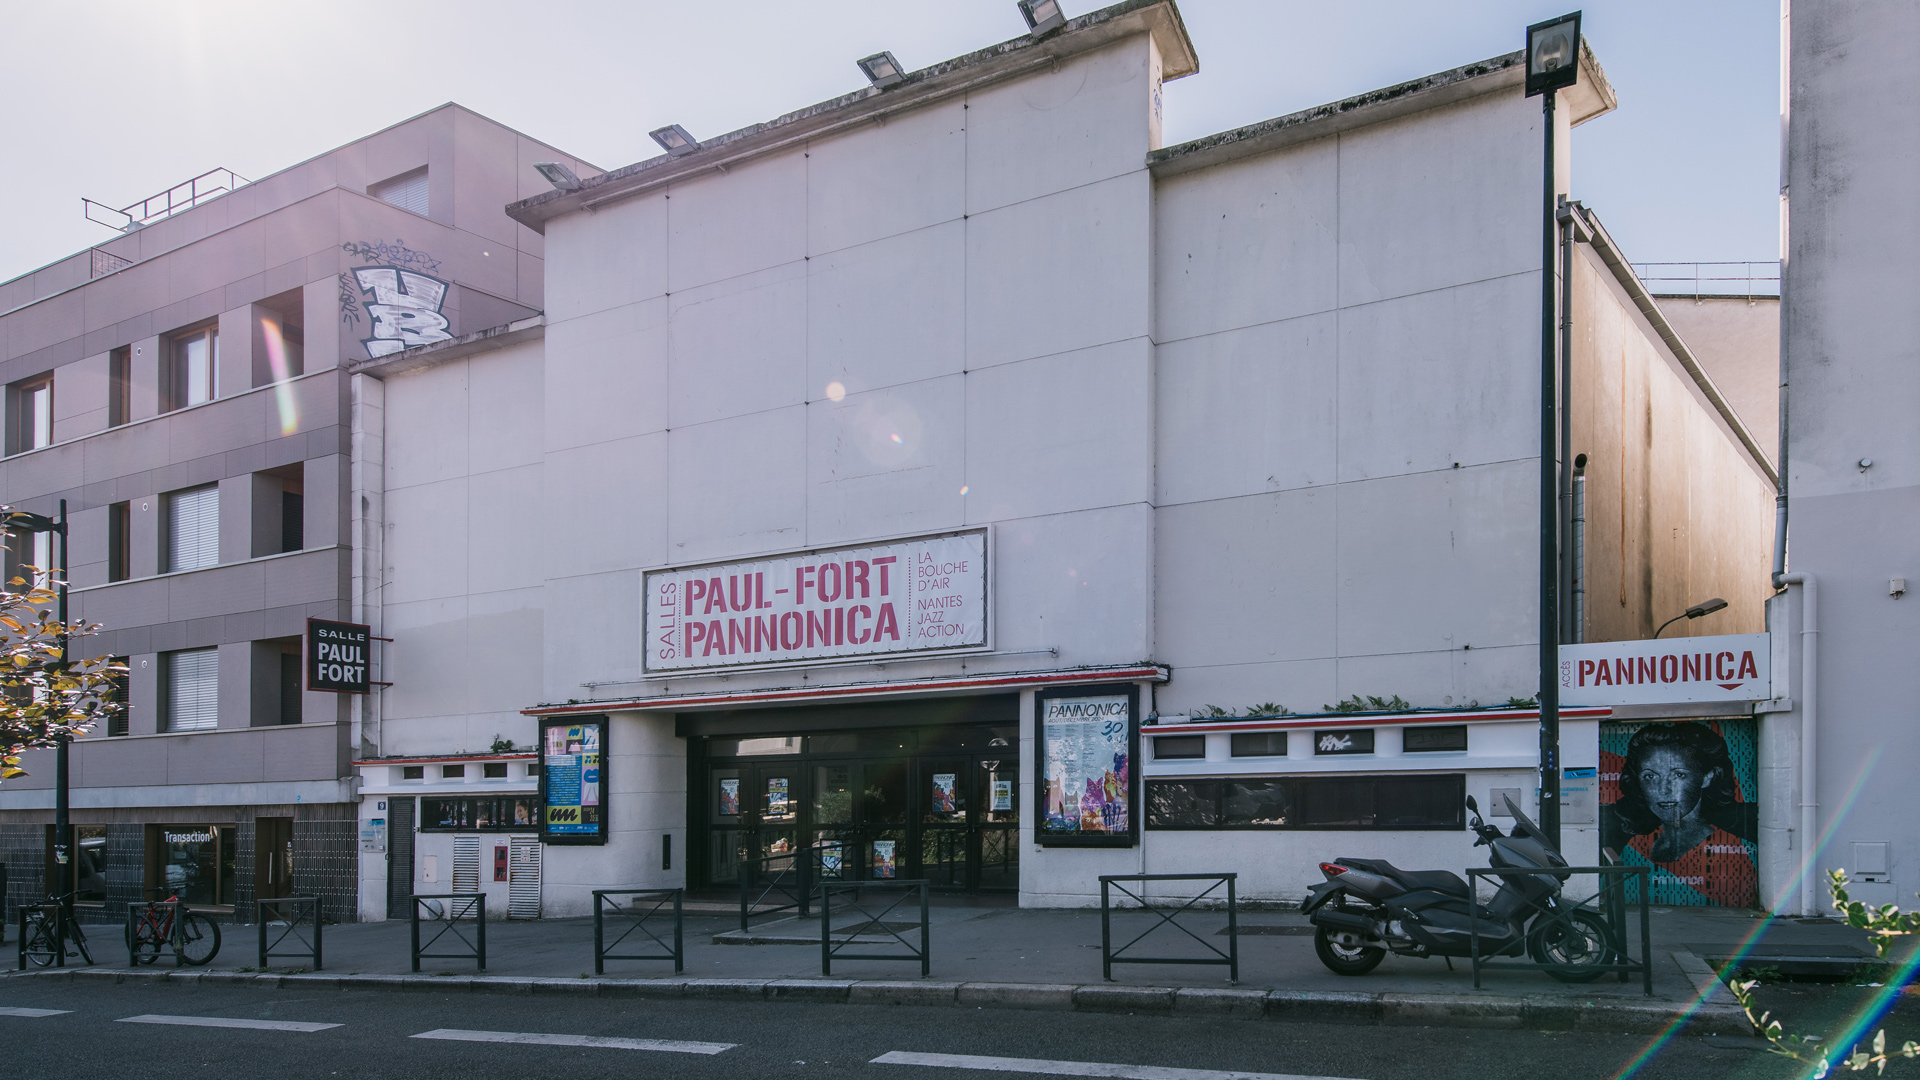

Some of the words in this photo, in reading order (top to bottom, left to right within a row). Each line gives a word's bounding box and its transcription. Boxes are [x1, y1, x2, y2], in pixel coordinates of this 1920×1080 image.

[918, 551, 932, 564] LA
[918, 560, 968, 578] BOUCHE
[684, 555, 897, 616] PAUL-FORT
[918, 577, 950, 592] D'AIR
[917, 595, 963, 610] NANTES
[660, 582, 677, 660] SALLES
[917, 611, 944, 625] JAZZ
[318, 628, 365, 642] SALLE
[684, 602, 901, 658] PANNONICA
[917, 623, 964, 639] ACTION
[318, 642, 365, 664] PAUL
[318, 663, 365, 684] FORT
[1562, 660, 1571, 688] ACCÈS
[1578, 650, 1759, 687] PANNONICA
[1048, 702, 1128, 718] PANNONICA
[1100, 720, 1124, 736] 30
[164, 831, 210, 843] Transaction
